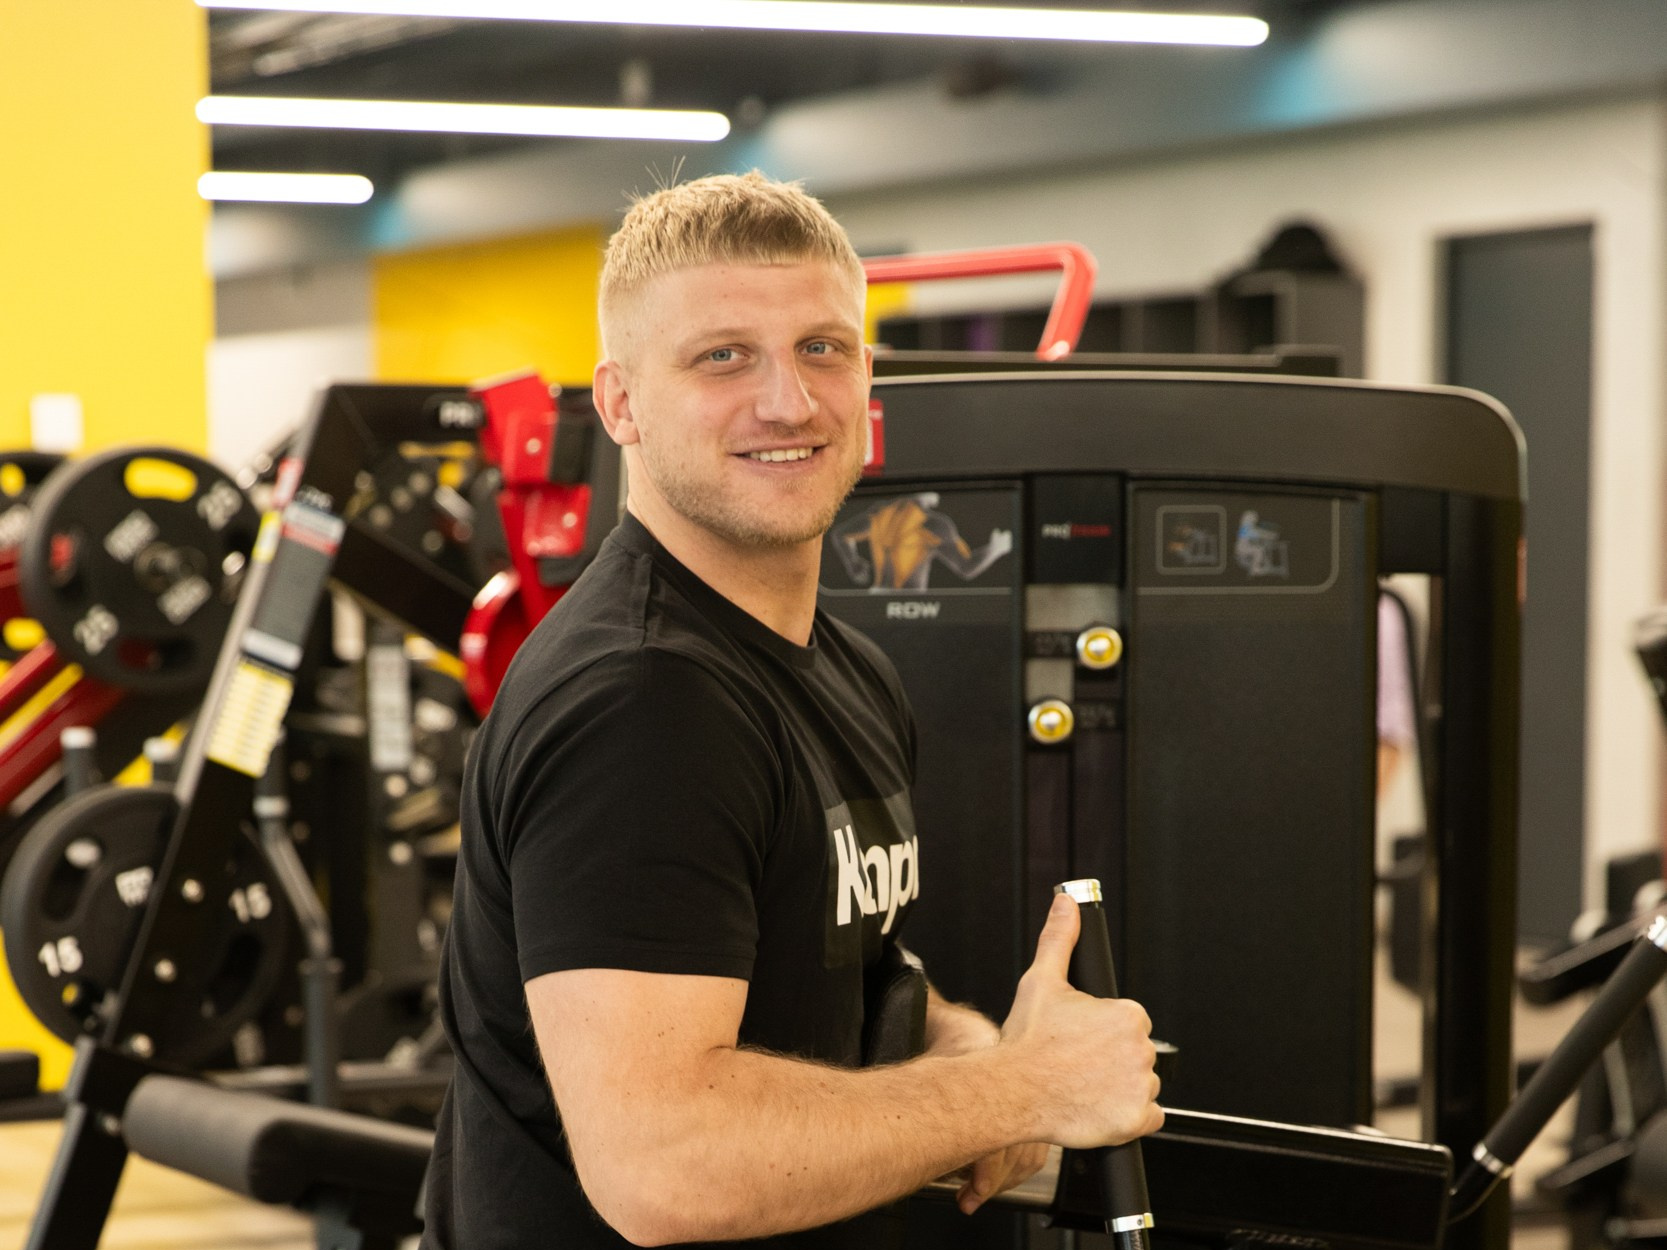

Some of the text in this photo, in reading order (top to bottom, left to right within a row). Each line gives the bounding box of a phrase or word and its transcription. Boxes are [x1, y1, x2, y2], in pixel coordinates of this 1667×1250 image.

[73, 605, 119, 655] 25
[886, 601, 941, 620] ROW
[229, 882, 272, 924] 15
[38, 936, 83, 978] 15
